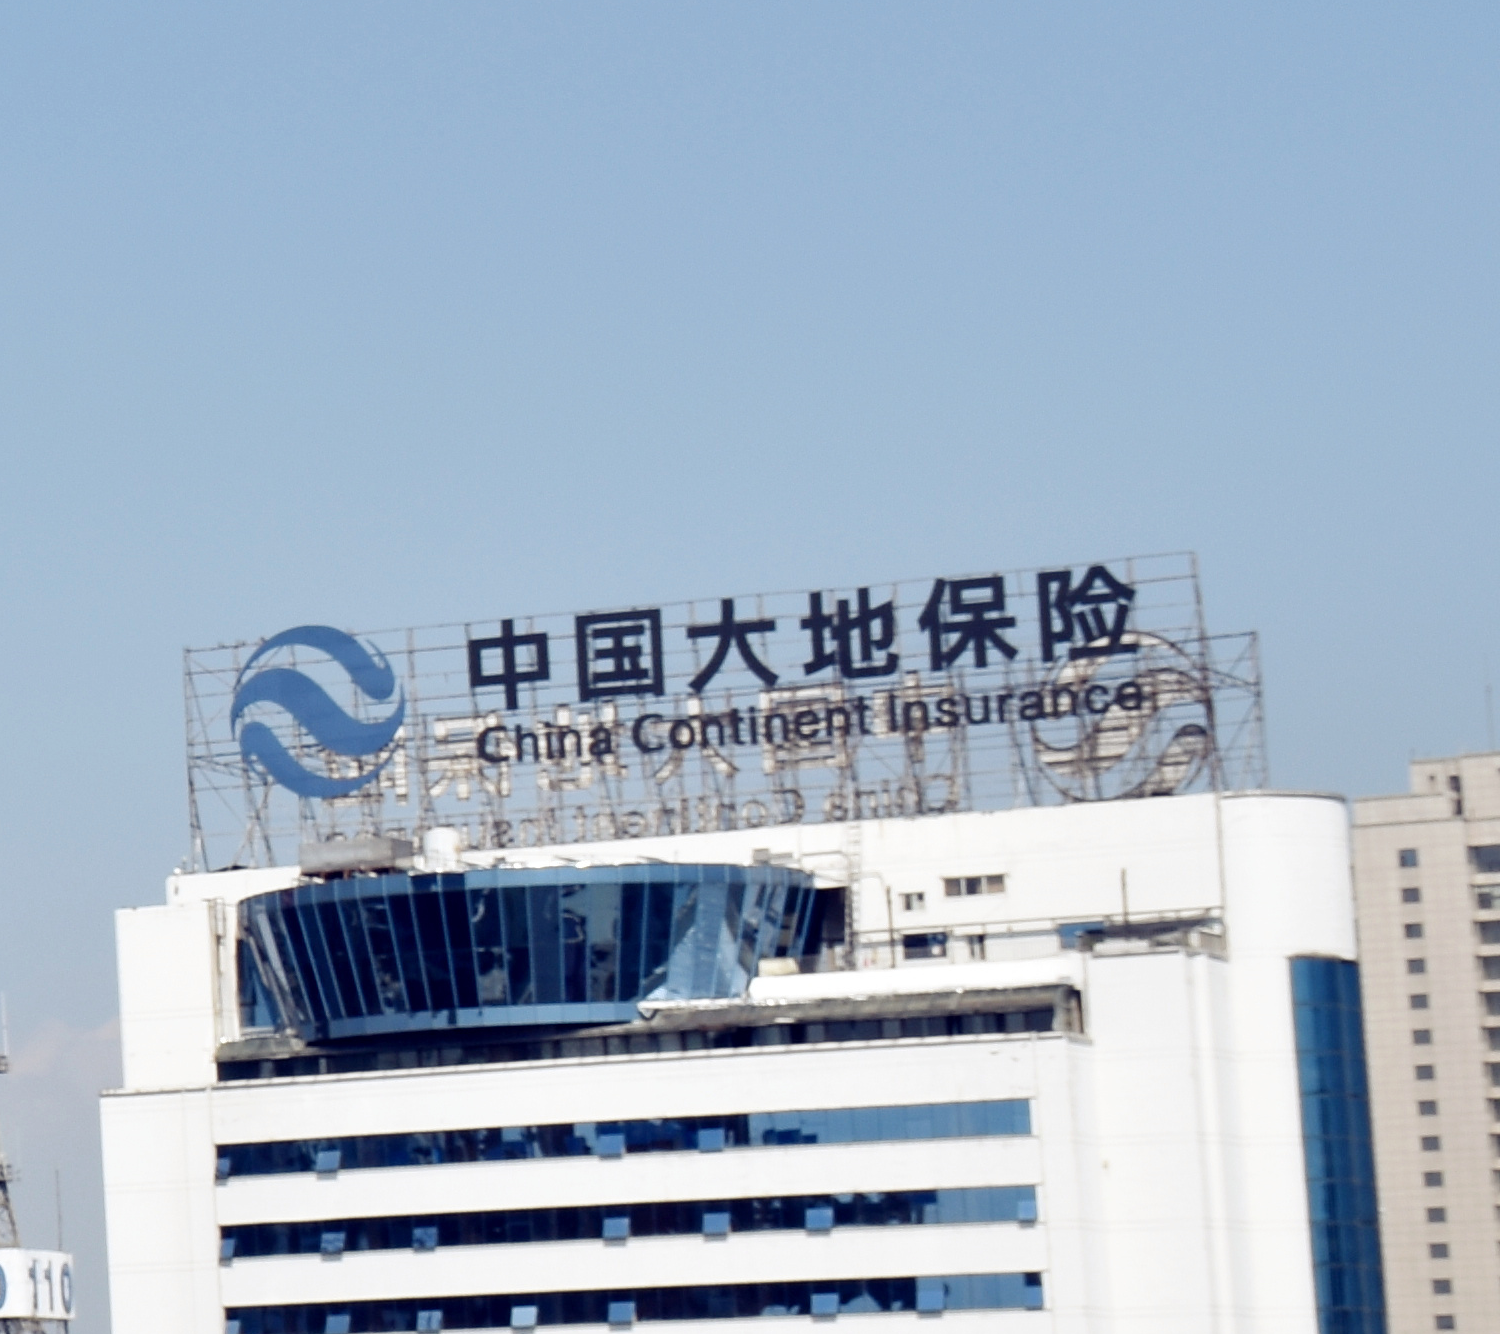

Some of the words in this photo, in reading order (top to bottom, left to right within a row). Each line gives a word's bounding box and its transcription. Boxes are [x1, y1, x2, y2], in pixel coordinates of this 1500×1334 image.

[467, 563, 1140, 710] 中国大地保险
[477, 720, 613, 763] China
[632, 694, 871, 754] Continent
[889, 675, 1148, 733] Insurance
